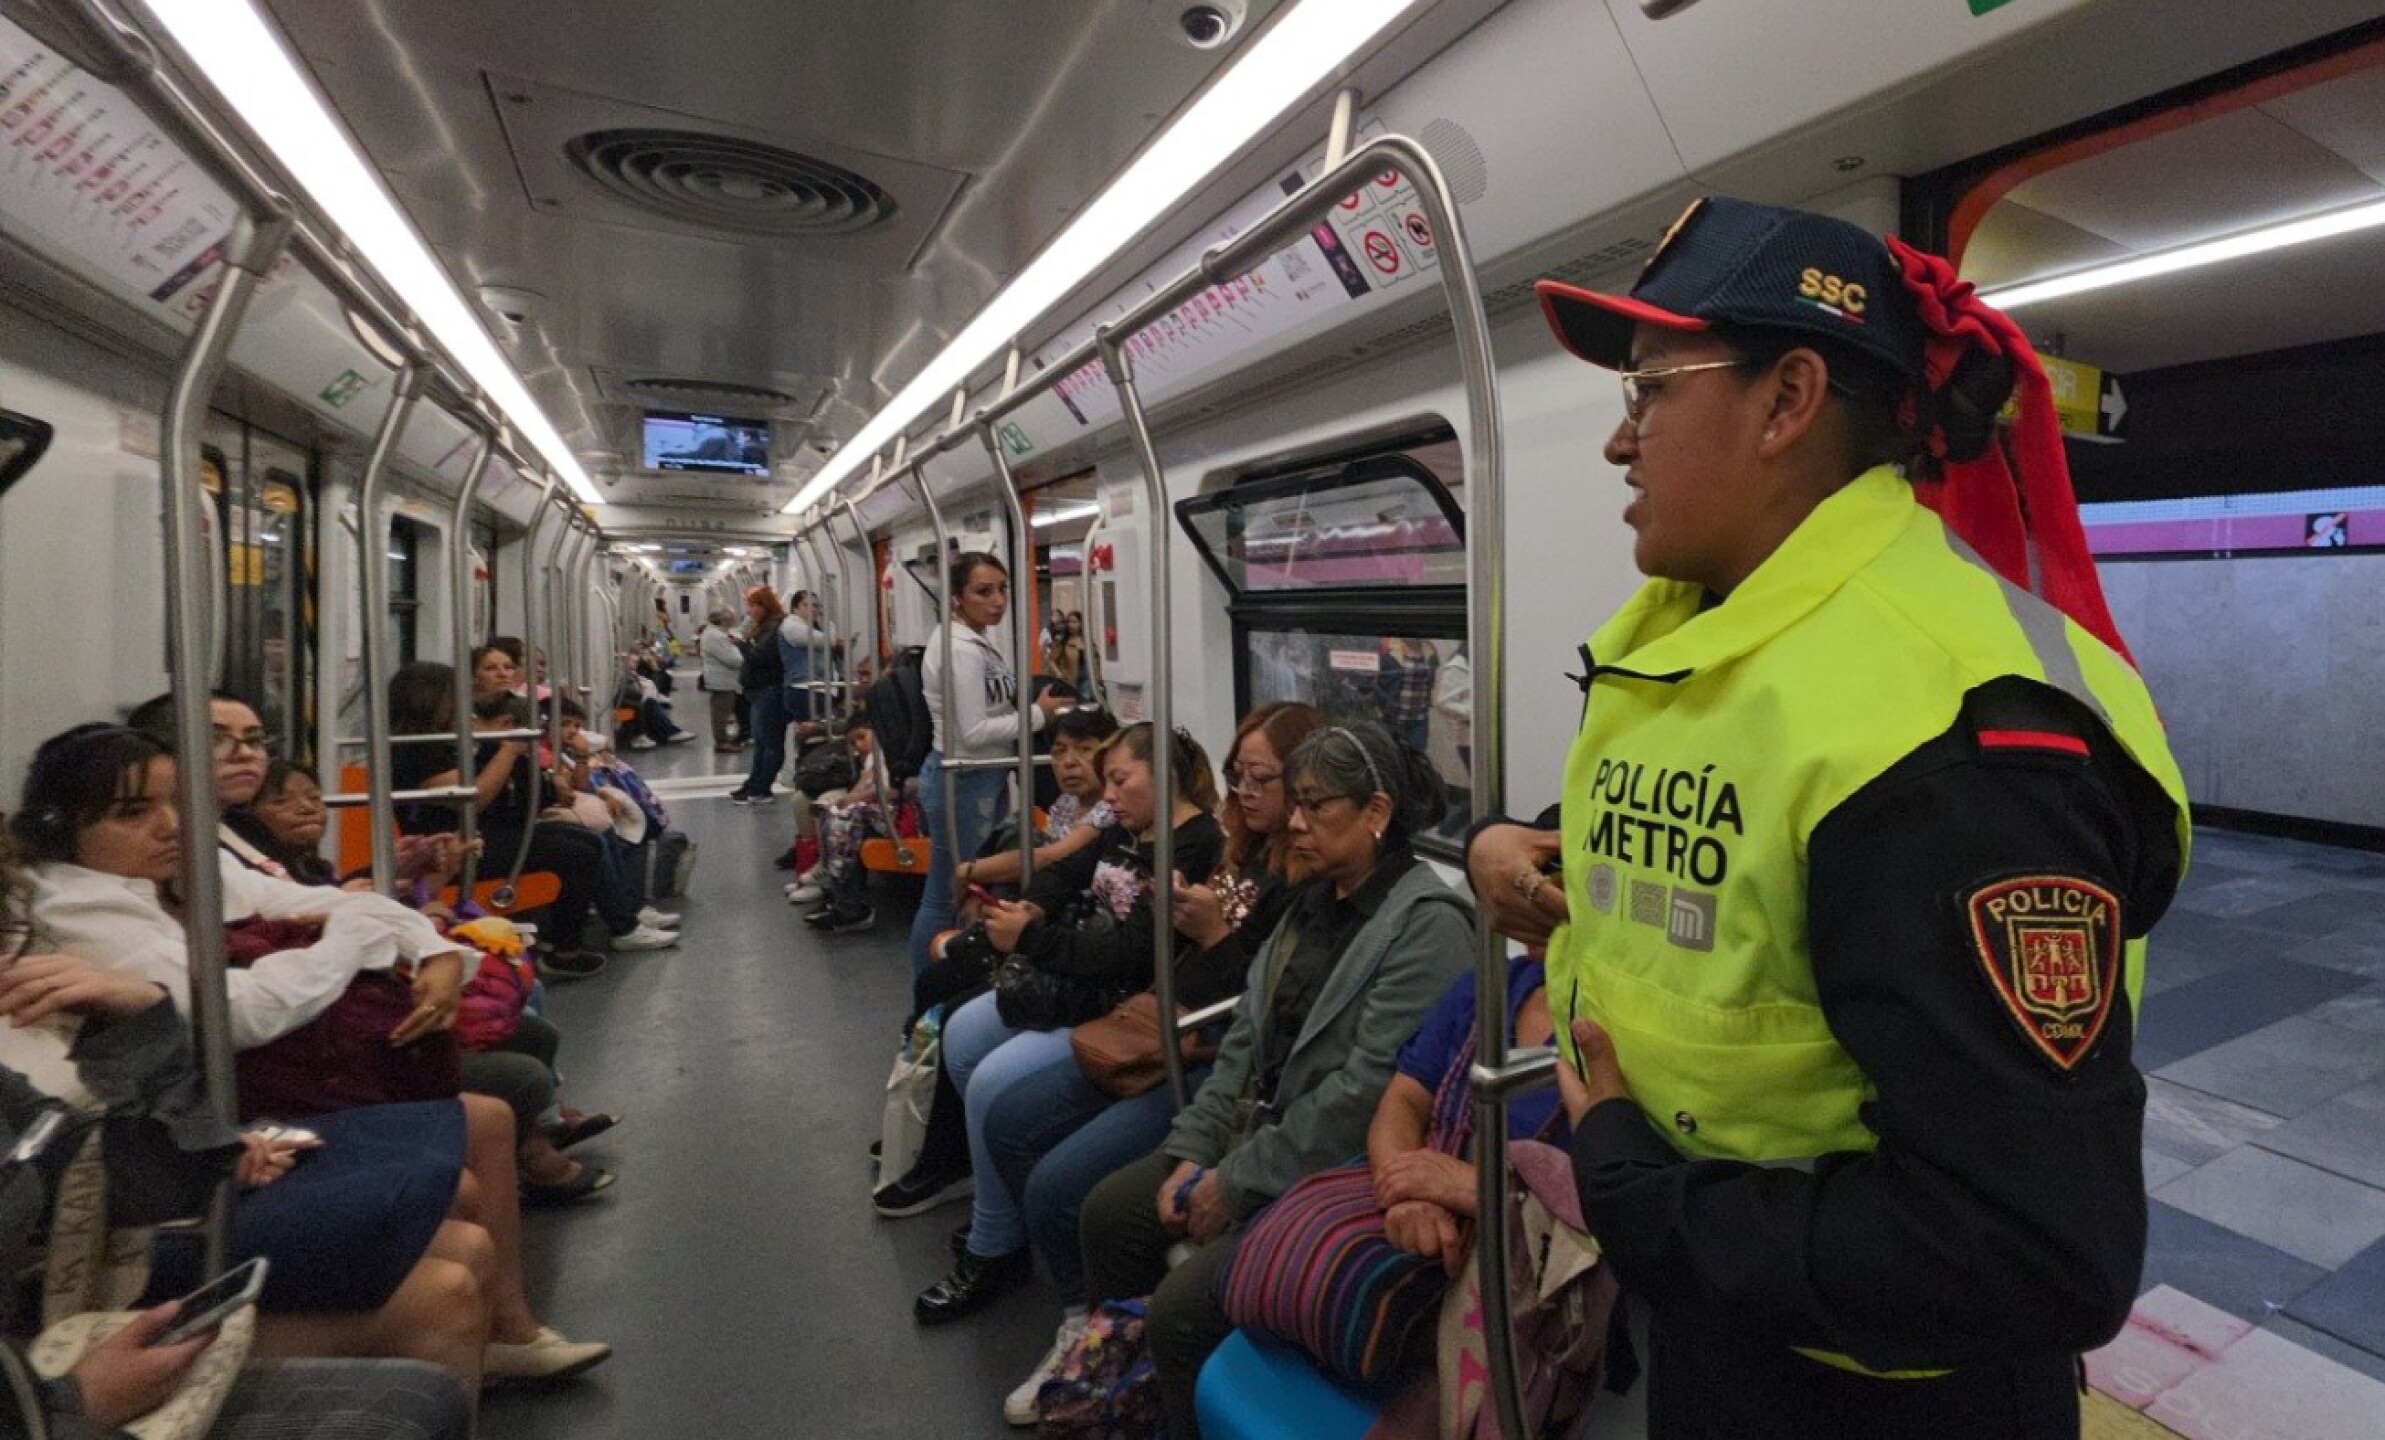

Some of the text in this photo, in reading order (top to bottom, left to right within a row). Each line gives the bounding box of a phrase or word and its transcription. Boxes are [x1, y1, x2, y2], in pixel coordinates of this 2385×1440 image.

[1801, 268, 1866, 312] SSC
[1590, 758, 1744, 835] POLICÍA
[1583, 810, 1728, 886] METRO
[1986, 887, 2106, 926] POLICIA
